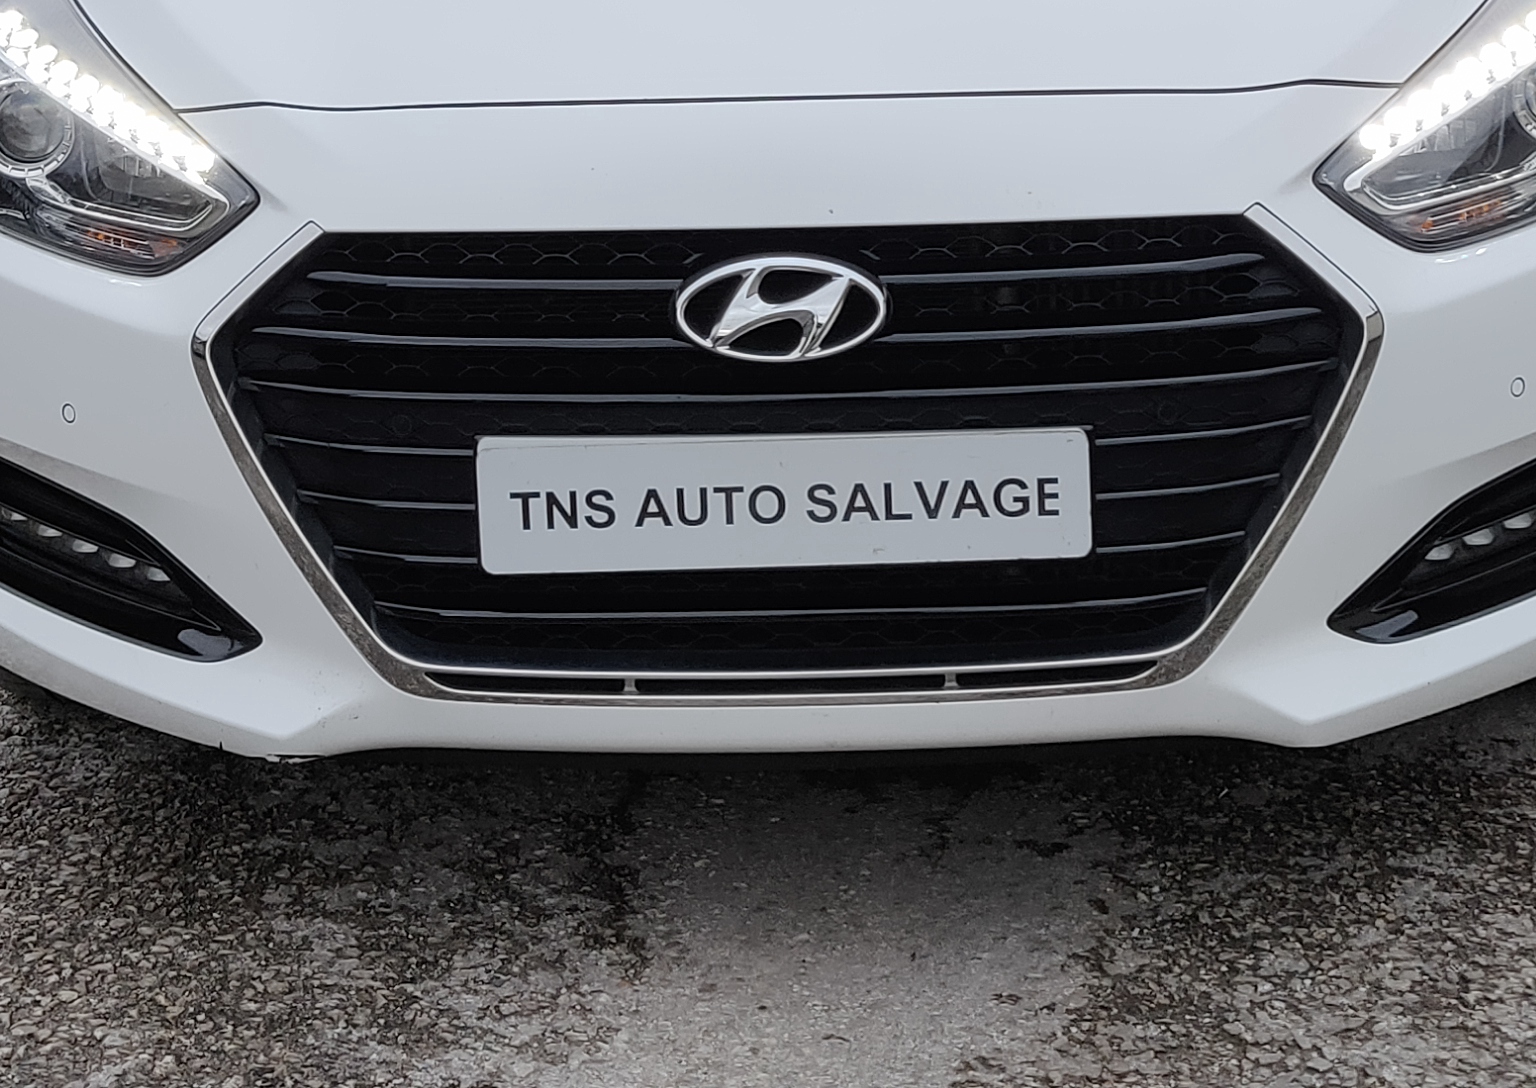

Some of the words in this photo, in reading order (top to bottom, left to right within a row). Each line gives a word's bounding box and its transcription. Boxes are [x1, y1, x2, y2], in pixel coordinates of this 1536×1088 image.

[510, 489, 616, 530] TNS
[635, 485, 787, 527] AUTO
[805, 477, 1060, 523] SALVAGE
